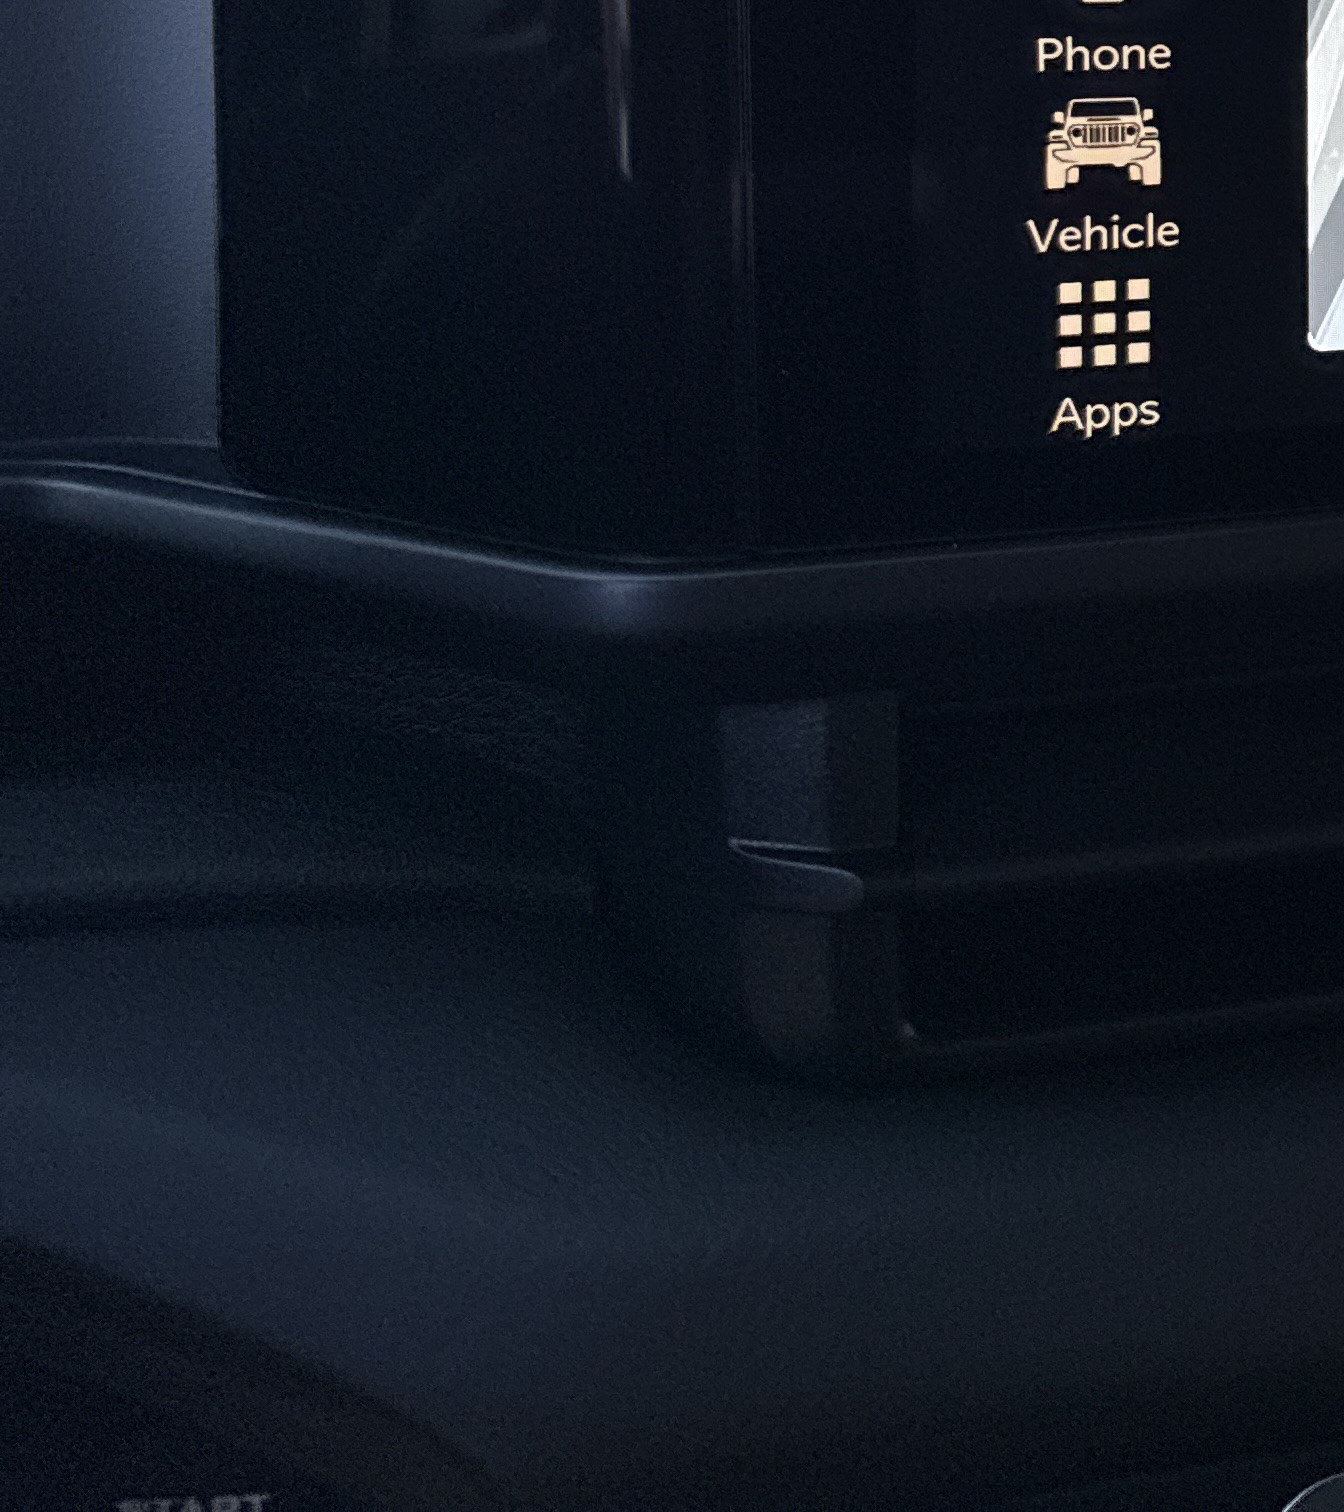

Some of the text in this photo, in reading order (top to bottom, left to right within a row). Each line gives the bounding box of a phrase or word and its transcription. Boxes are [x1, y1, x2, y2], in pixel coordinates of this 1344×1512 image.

[1036, 35, 1172, 72] Phone
[1026, 212, 1181, 254] Vehicle
[1049, 396, 1162, 439] Apps
